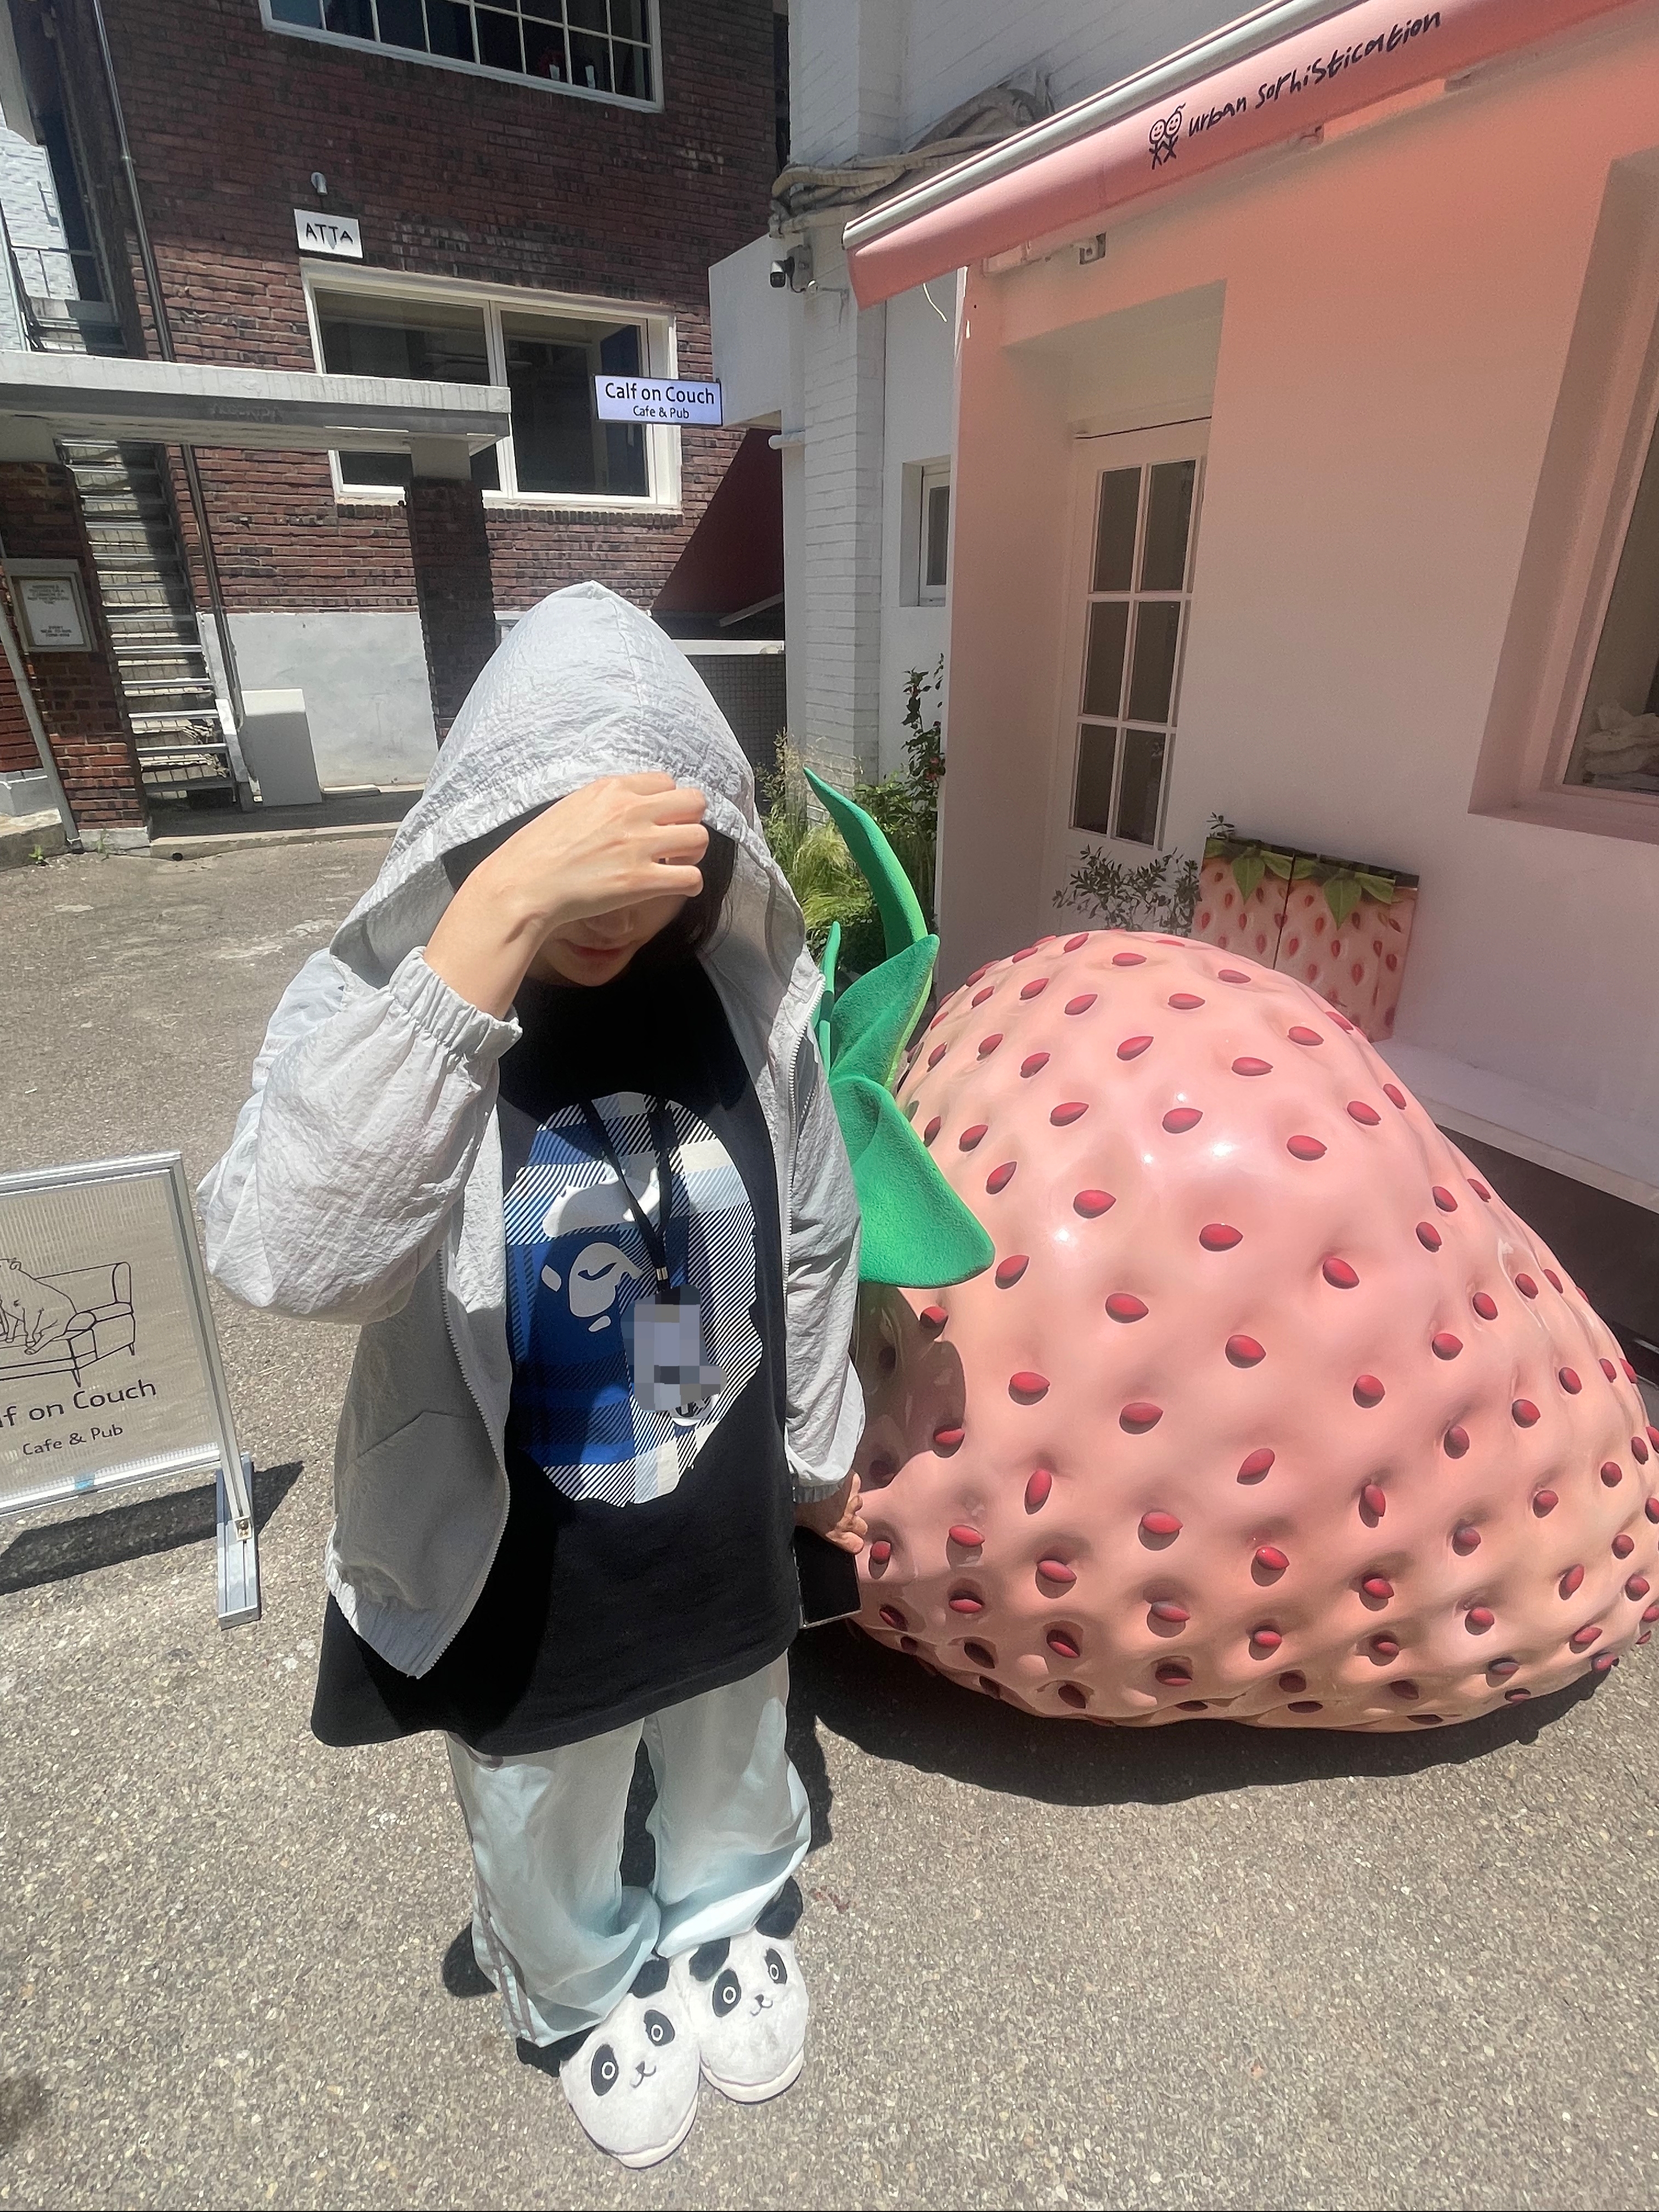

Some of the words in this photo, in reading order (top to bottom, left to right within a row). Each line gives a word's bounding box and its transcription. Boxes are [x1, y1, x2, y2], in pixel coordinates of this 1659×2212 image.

[1188, 96, 1247, 137] urban
[306, 222, 354, 245] ATTA
[605, 382, 637, 399] Calf
[641, 388, 661, 401] on
[666, 386, 714, 404] Couch
[633, 405, 656, 417] Cafe
[659, 407, 668, 418] &
[670, 408, 690, 419] Pub
[29, 1403, 65, 1420] on
[73, 1379, 157, 1409] Couch
[22, 1438, 63, 1455] Cafe
[69, 1432, 87, 1445] &
[90, 1424, 123, 1441] Pub
